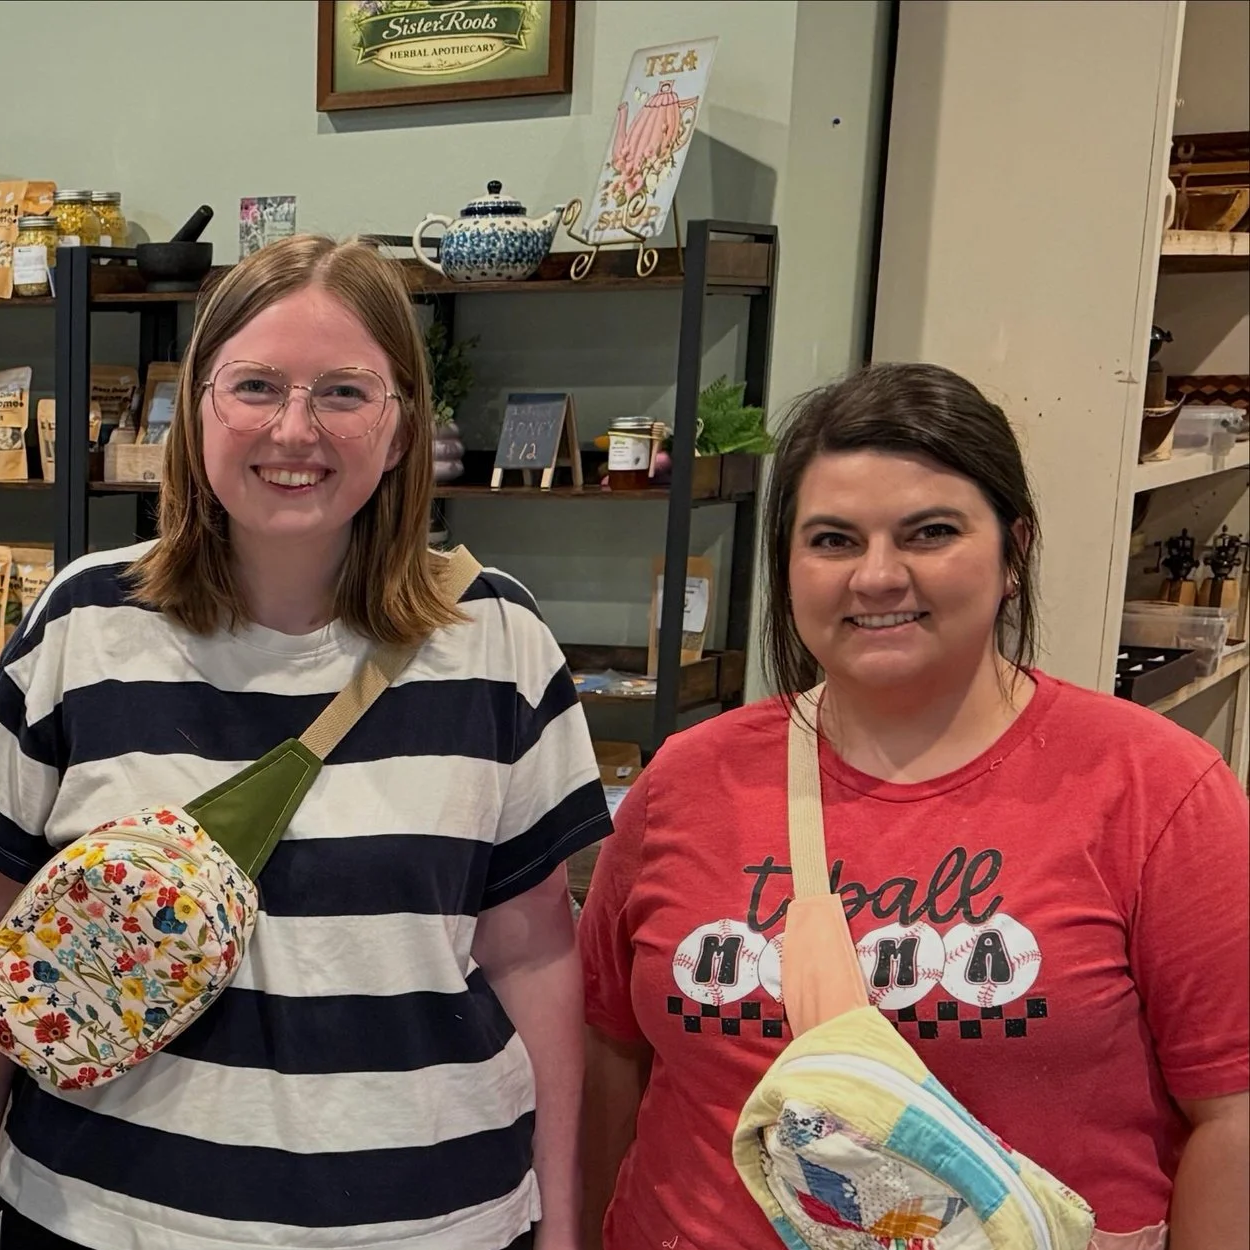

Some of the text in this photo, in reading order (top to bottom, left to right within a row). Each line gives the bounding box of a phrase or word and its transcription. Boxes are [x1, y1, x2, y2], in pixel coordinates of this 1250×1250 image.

[390, 43, 496, 60] HERBAL APOTHECARY
[646, 50, 699, 77] TEA
[692, 931, 1015, 990] MMA
